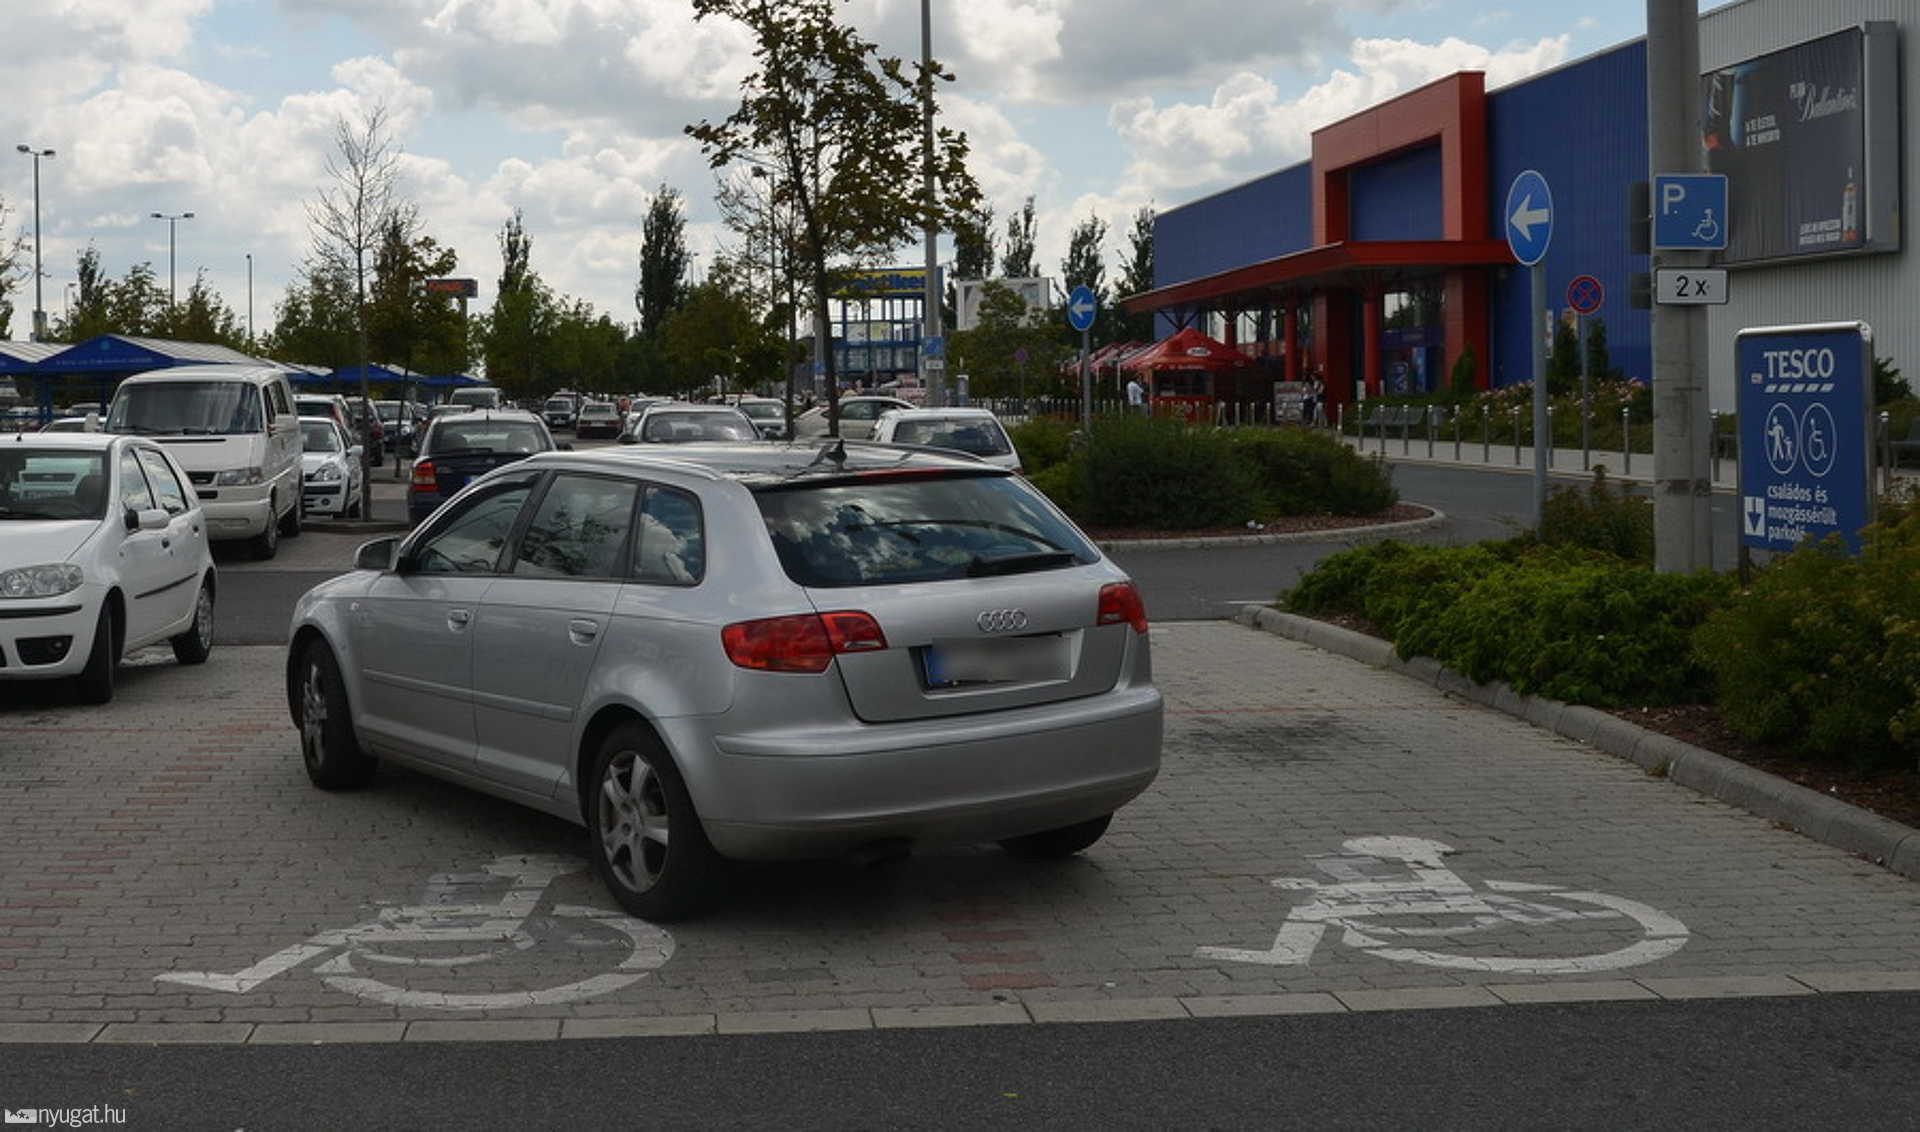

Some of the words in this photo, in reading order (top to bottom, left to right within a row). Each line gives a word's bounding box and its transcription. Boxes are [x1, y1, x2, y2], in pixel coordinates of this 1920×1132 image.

[1663, 183, 1686, 215] P
[1763, 347, 1835, 379] TESCO
[1767, 482, 1812, 502] családos
[1815, 484, 1829, 504] és
